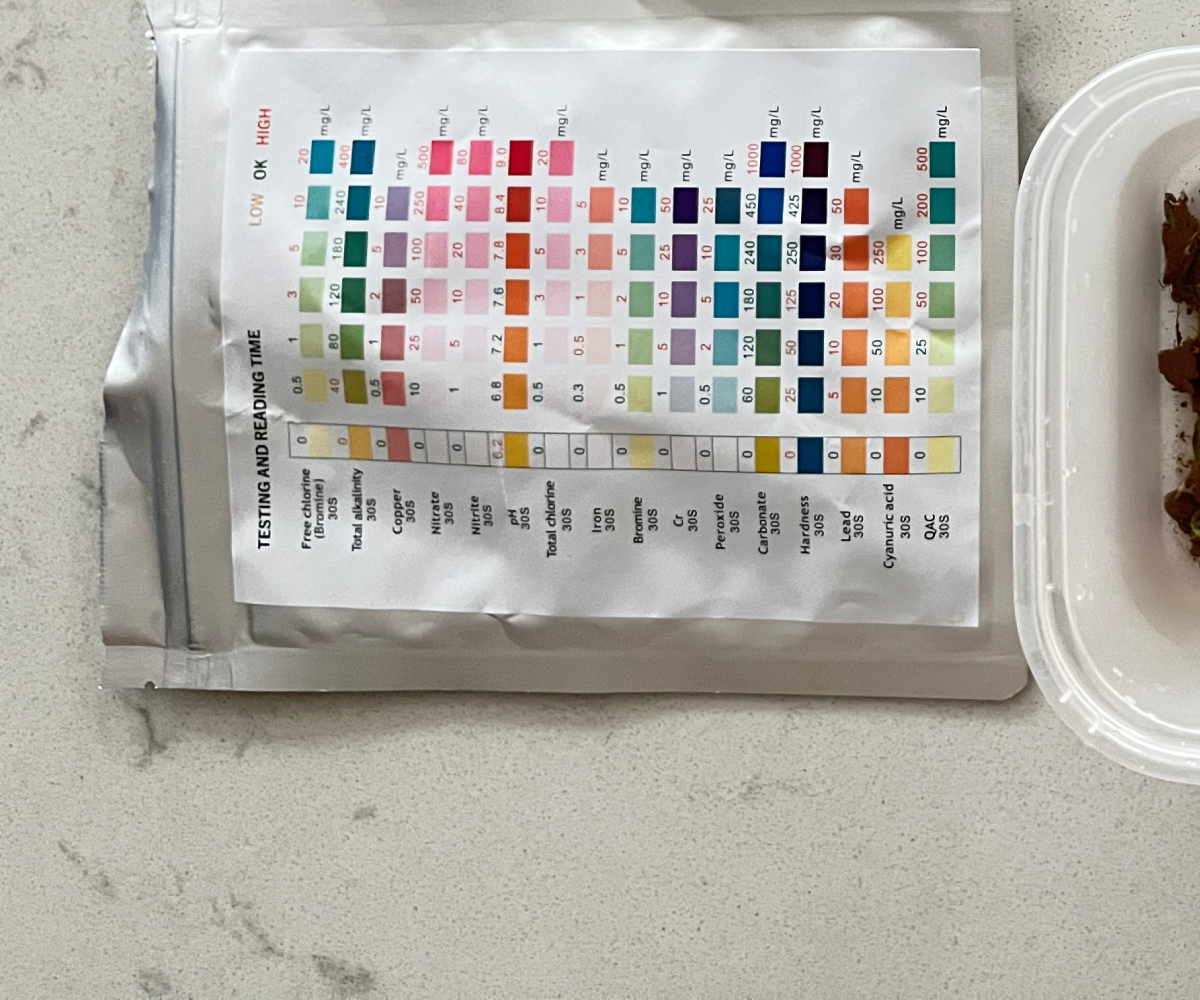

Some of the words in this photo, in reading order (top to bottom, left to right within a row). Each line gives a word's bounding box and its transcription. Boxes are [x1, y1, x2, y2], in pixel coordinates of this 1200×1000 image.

[256, 108, 271, 145] HIGH
[320, 105, 332, 136] mg/L
[361, 105, 372, 136] mg/L
[439, 106, 450, 137] mg/L
[478, 106, 490, 137] mg/L
[558, 106, 569, 137] mg/L
[768, 106, 781, 138] mg/L
[811, 106, 824, 138] mg/L
[937, 106, 950, 138] mg/L
[298, 148, 309, 164] 20
[339, 145, 350, 168] 400
[396, 149, 408, 180] mg/L
[417, 145, 429, 169] 500
[456, 149, 468, 165] 80
[496, 147, 507, 168] 9.0
[537, 150, 549, 166] 20
[598, 149, 610, 181] mg/L
[639, 150, 651, 182] mg/L
[681, 150, 693, 182] mg/L
[723, 150, 736, 182] mg/L
[747, 143, 759, 174] 1000
[790, 145, 802, 174] 1000
[851, 151, 863, 183] mg/L
[916, 147, 928, 171] 500
[253, 160, 267, 180] OK
[248, 193, 264, 226] LOW
[294, 195, 305, 208] 10
[334, 191, 345, 214] 240
[374, 195, 385, 209] 10
[413, 191, 425, 215] 250
[454, 195, 465, 212] 40
[494, 194, 505, 214] 8.4
[535, 196, 547, 211] 10
[618, 197, 629, 212] 10
[660, 197, 671, 213] 50
[702, 197, 714, 213] 25
[745, 193, 756, 218] 450
[788, 194, 800, 217] 425
[831, 198, 842, 214] 50
[916, 193, 928, 218] 200
[892, 197, 906, 230] mg/L
[332, 237, 343, 260] 180
[411, 238, 422, 261] 100
[452, 242, 463, 258] 20
[493, 241, 504, 260] 7.8
[659, 244, 670, 260] 25
[701, 245, 712, 260] 10
[744, 241, 755, 265] 240
[786, 241, 798, 265] 250
[830, 245, 842, 261] 30
[873, 240, 884, 265] 250
[916, 241, 928, 264] 100
[329, 283, 342, 306] 120
[370, 292, 381, 300] 2
[410, 288, 422, 304] 50
[452, 289, 463, 303] 10
[493, 287, 504, 307] 7.6
[616, 295, 627, 303] 2
[658, 292, 669, 307] 10
[743, 288, 754, 312] 180
[785, 289, 797, 311] 125
[829, 292, 840, 309] 20
[872, 288, 884, 311] 100
[916, 292, 927, 308] 50
[247, 330, 263, 367] TIME
[328, 333, 339, 350] 80
[409, 335, 420, 351] 25
[491, 334, 503, 354] 7.2
[573, 335, 584, 356] 0.5
[700, 343, 711, 351] 2
[743, 335, 754, 359] 120
[785, 340, 797, 355] 50
[828, 340, 840, 355] 10
[871, 340, 883, 355] 50
[915, 339, 927, 355] 25
[291, 376, 304, 394] 0.5
[328, 378, 340, 394] 40
[369, 379, 381, 397] 0.5
[409, 382, 420, 396] 10
[491, 381, 502, 402] 6.8
[532, 382, 544, 403] 0.5
[572, 384, 584, 403] 0.3
[614, 383, 625, 404] 0.5
[699, 384, 710, 405] 0.5
[742, 387, 753, 403] 60
[784, 388, 796, 403] 25
[828, 391, 839, 399] 5
[870, 388, 882, 403] 10
[915, 387, 926, 403] 10
[252, 372, 268, 441] READING
[255, 444, 270, 478] AND
[492, 439, 503, 460] 6.2
[301, 468, 312, 518] chlorine
[351, 468, 364, 520] alkalinity
[545, 480, 556, 527] chlorine
[883, 484, 894, 511] acid
[257, 481, 271, 549] TESTING
[312, 478, 326, 539] (Bromine)
[327, 497, 338, 520] 30S
[366, 498, 376, 521] 30S
[392, 488, 405, 534] Copper
[405, 500, 416, 523] 30S
[431, 491, 441, 534] Nitrate
[443, 502, 454, 524] 30S
[470, 495, 481, 535] Nitrite
[482, 504, 493, 527] 30S
[507, 509, 520, 526] pH
[519, 507, 530, 530] 30S
[561, 508, 572, 532] 30S
[591, 507, 602, 533] Iron
[604, 509, 615, 531] 30S
[647, 509, 658, 531] 30S
[633, 497, 644, 544] Bromine
[673, 514, 684, 527] Cr
[687, 509, 698, 532] 30S
[713, 494, 726, 550] Peroxide
[729, 511, 740, 533] 30S
[757, 491, 769, 555] Carbonate
[769, 513, 780, 535] 30S
[799, 496, 810, 554] Hardness
[813, 513, 824, 537] 30S
[840, 511, 851, 542] Lead
[853, 515, 864, 538] 30S
[899, 515, 911, 539] 30S
[924, 514, 937, 540] QAC
[939, 515, 949, 539] 30S
[301, 522, 312, 549] Free
[351, 523, 362, 552] Total
[546, 530, 557, 558] Total
[882, 514, 897, 569] Cyanuric
